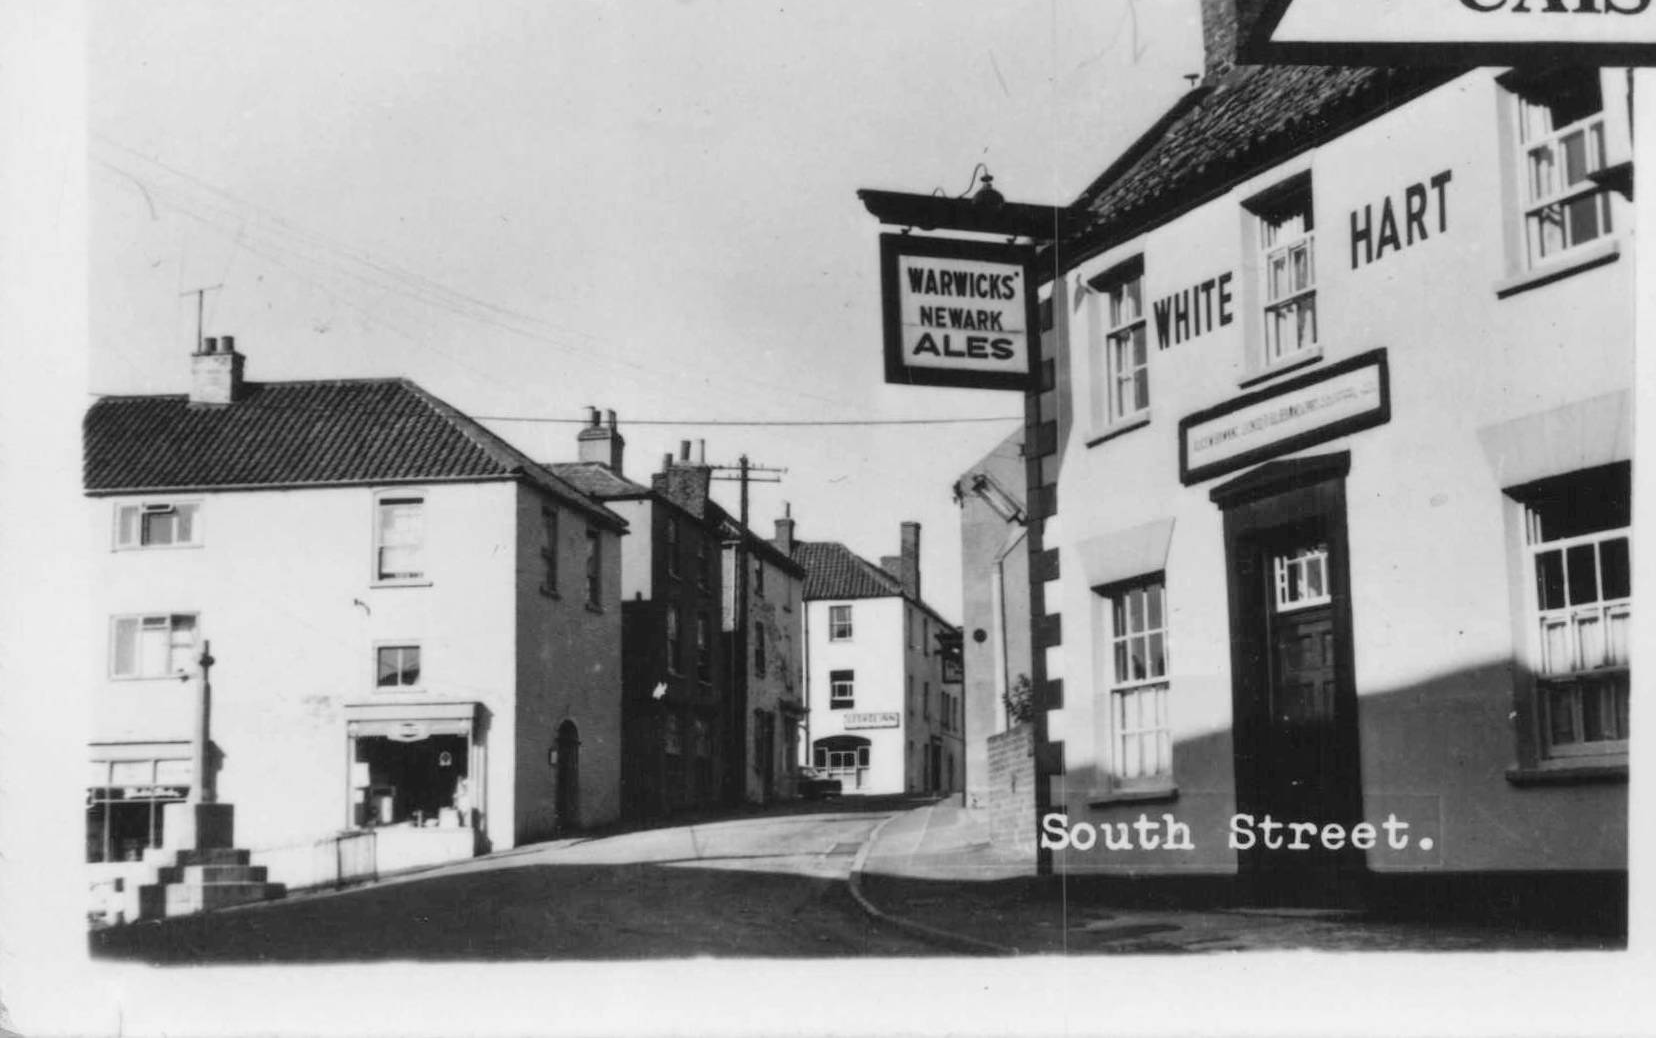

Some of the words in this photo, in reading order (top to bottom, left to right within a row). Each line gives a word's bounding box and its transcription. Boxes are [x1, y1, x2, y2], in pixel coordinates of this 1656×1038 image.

[1153, 270, 1233, 351] WHITE
[1350, 168, 1453, 270] HART
[919, 305, 1004, 331] NEWARK
[912, 331, 1015, 360] ALES
